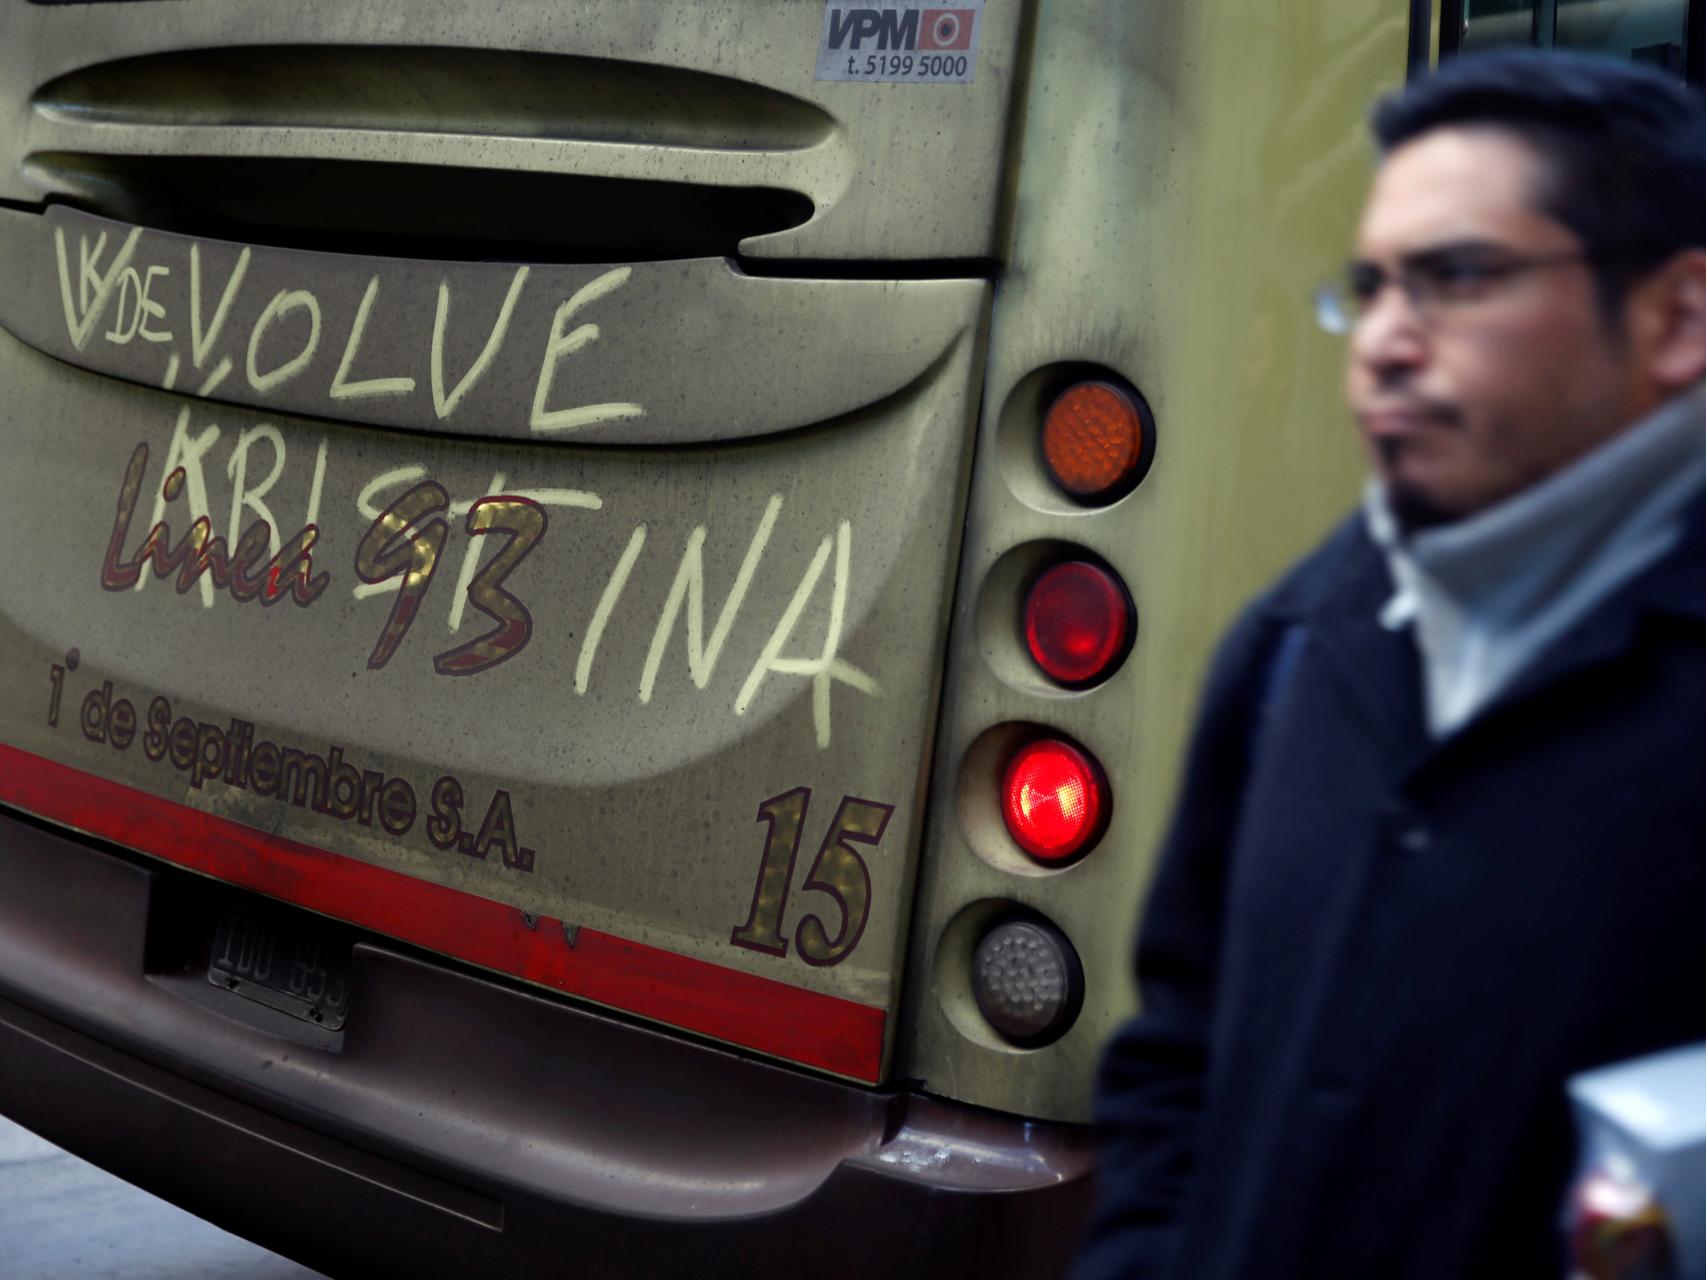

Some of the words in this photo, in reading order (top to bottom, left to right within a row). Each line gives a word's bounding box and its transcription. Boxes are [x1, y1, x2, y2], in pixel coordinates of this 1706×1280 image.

[828, 9, 919, 50] VPM
[847, 57, 859, 75] t.
[864, 55, 914, 75] 5199
[918, 56, 967, 76] 5000
[101, 441, 330, 607] Linea
[354, 480, 548, 676] 93
[81, 680, 137, 750] de
[144, 695, 417, 836] Septiembre
[427, 775, 536, 873] S.A.
[730, 786, 896, 967] 15
